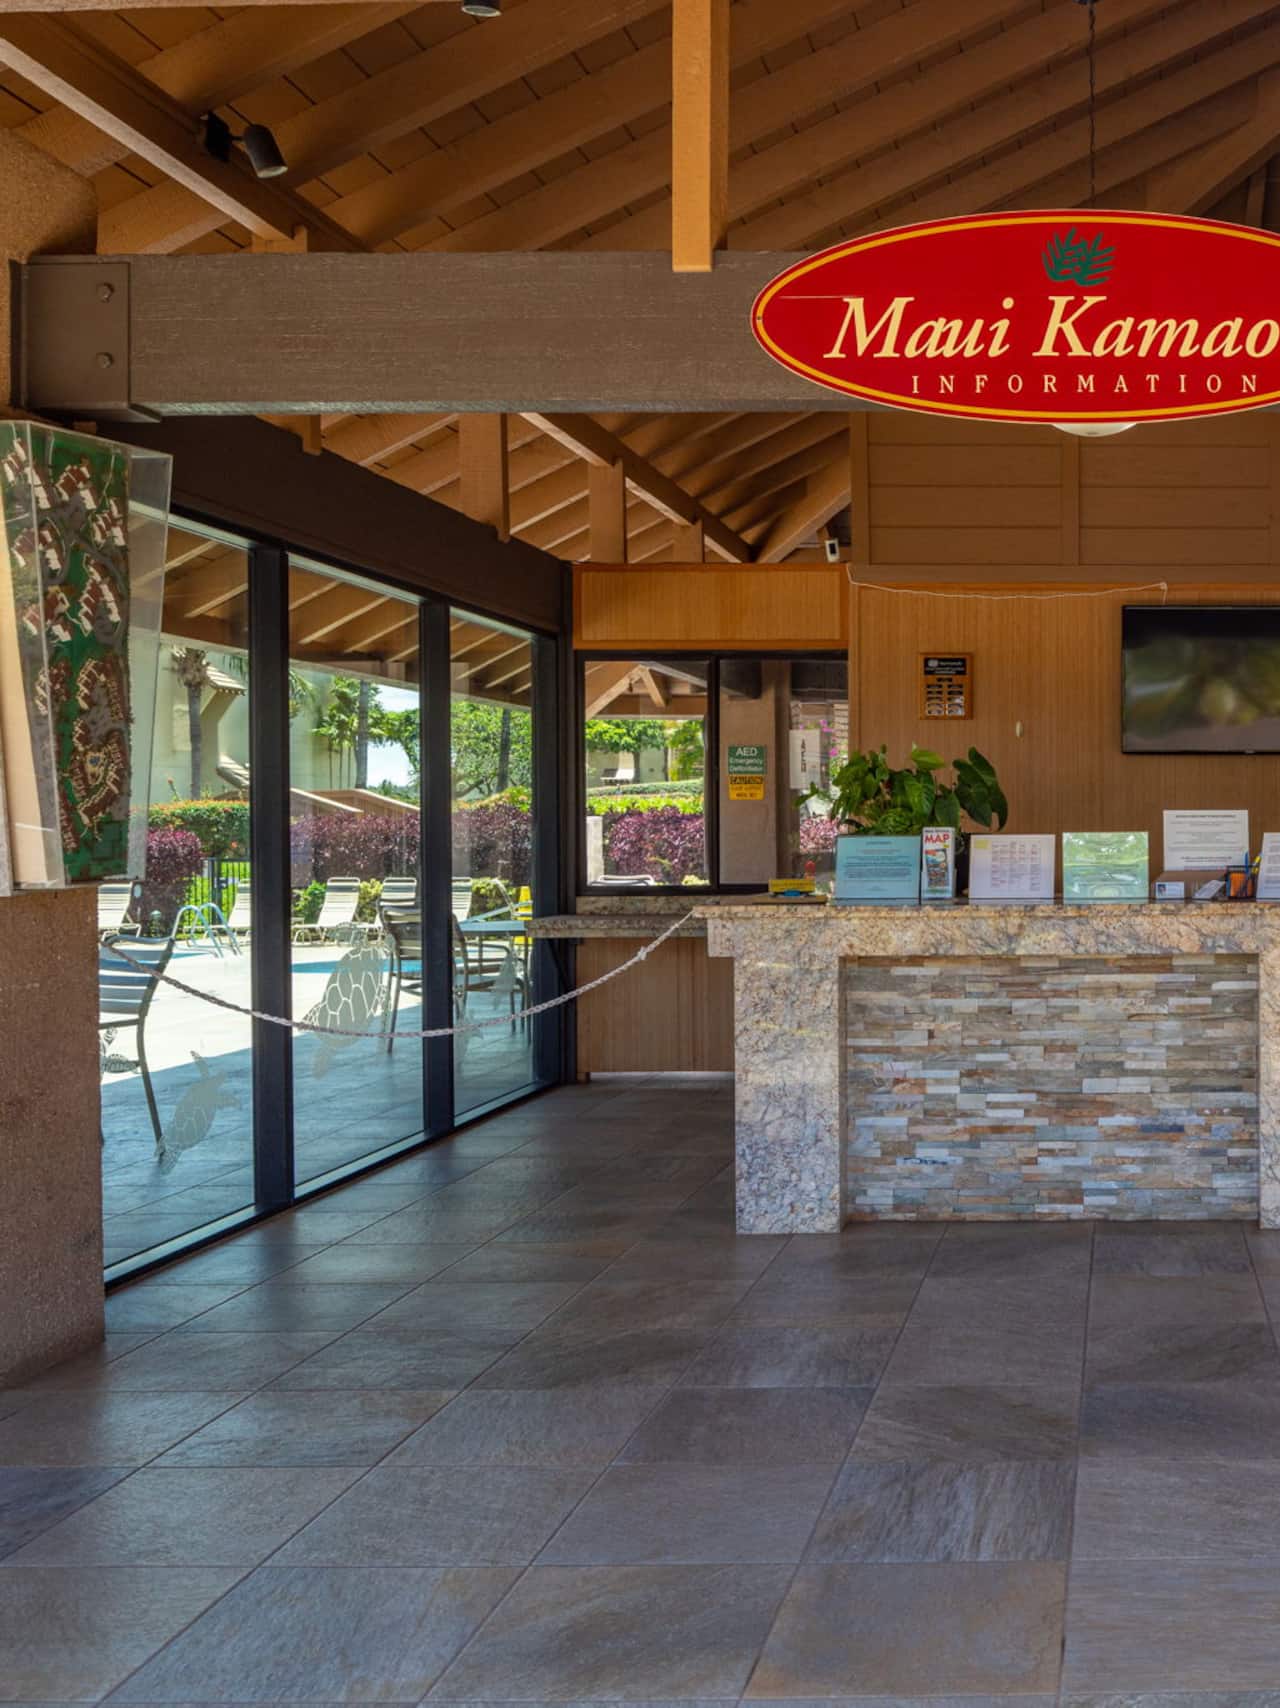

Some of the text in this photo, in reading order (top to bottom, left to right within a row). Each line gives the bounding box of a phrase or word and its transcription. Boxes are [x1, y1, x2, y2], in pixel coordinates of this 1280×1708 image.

[823, 296, 1015, 359] Maui
[911, 374, 1258, 395] INFORMATION
[735, 747, 758, 757] AED
[925, 832, 950, 844] MAP
